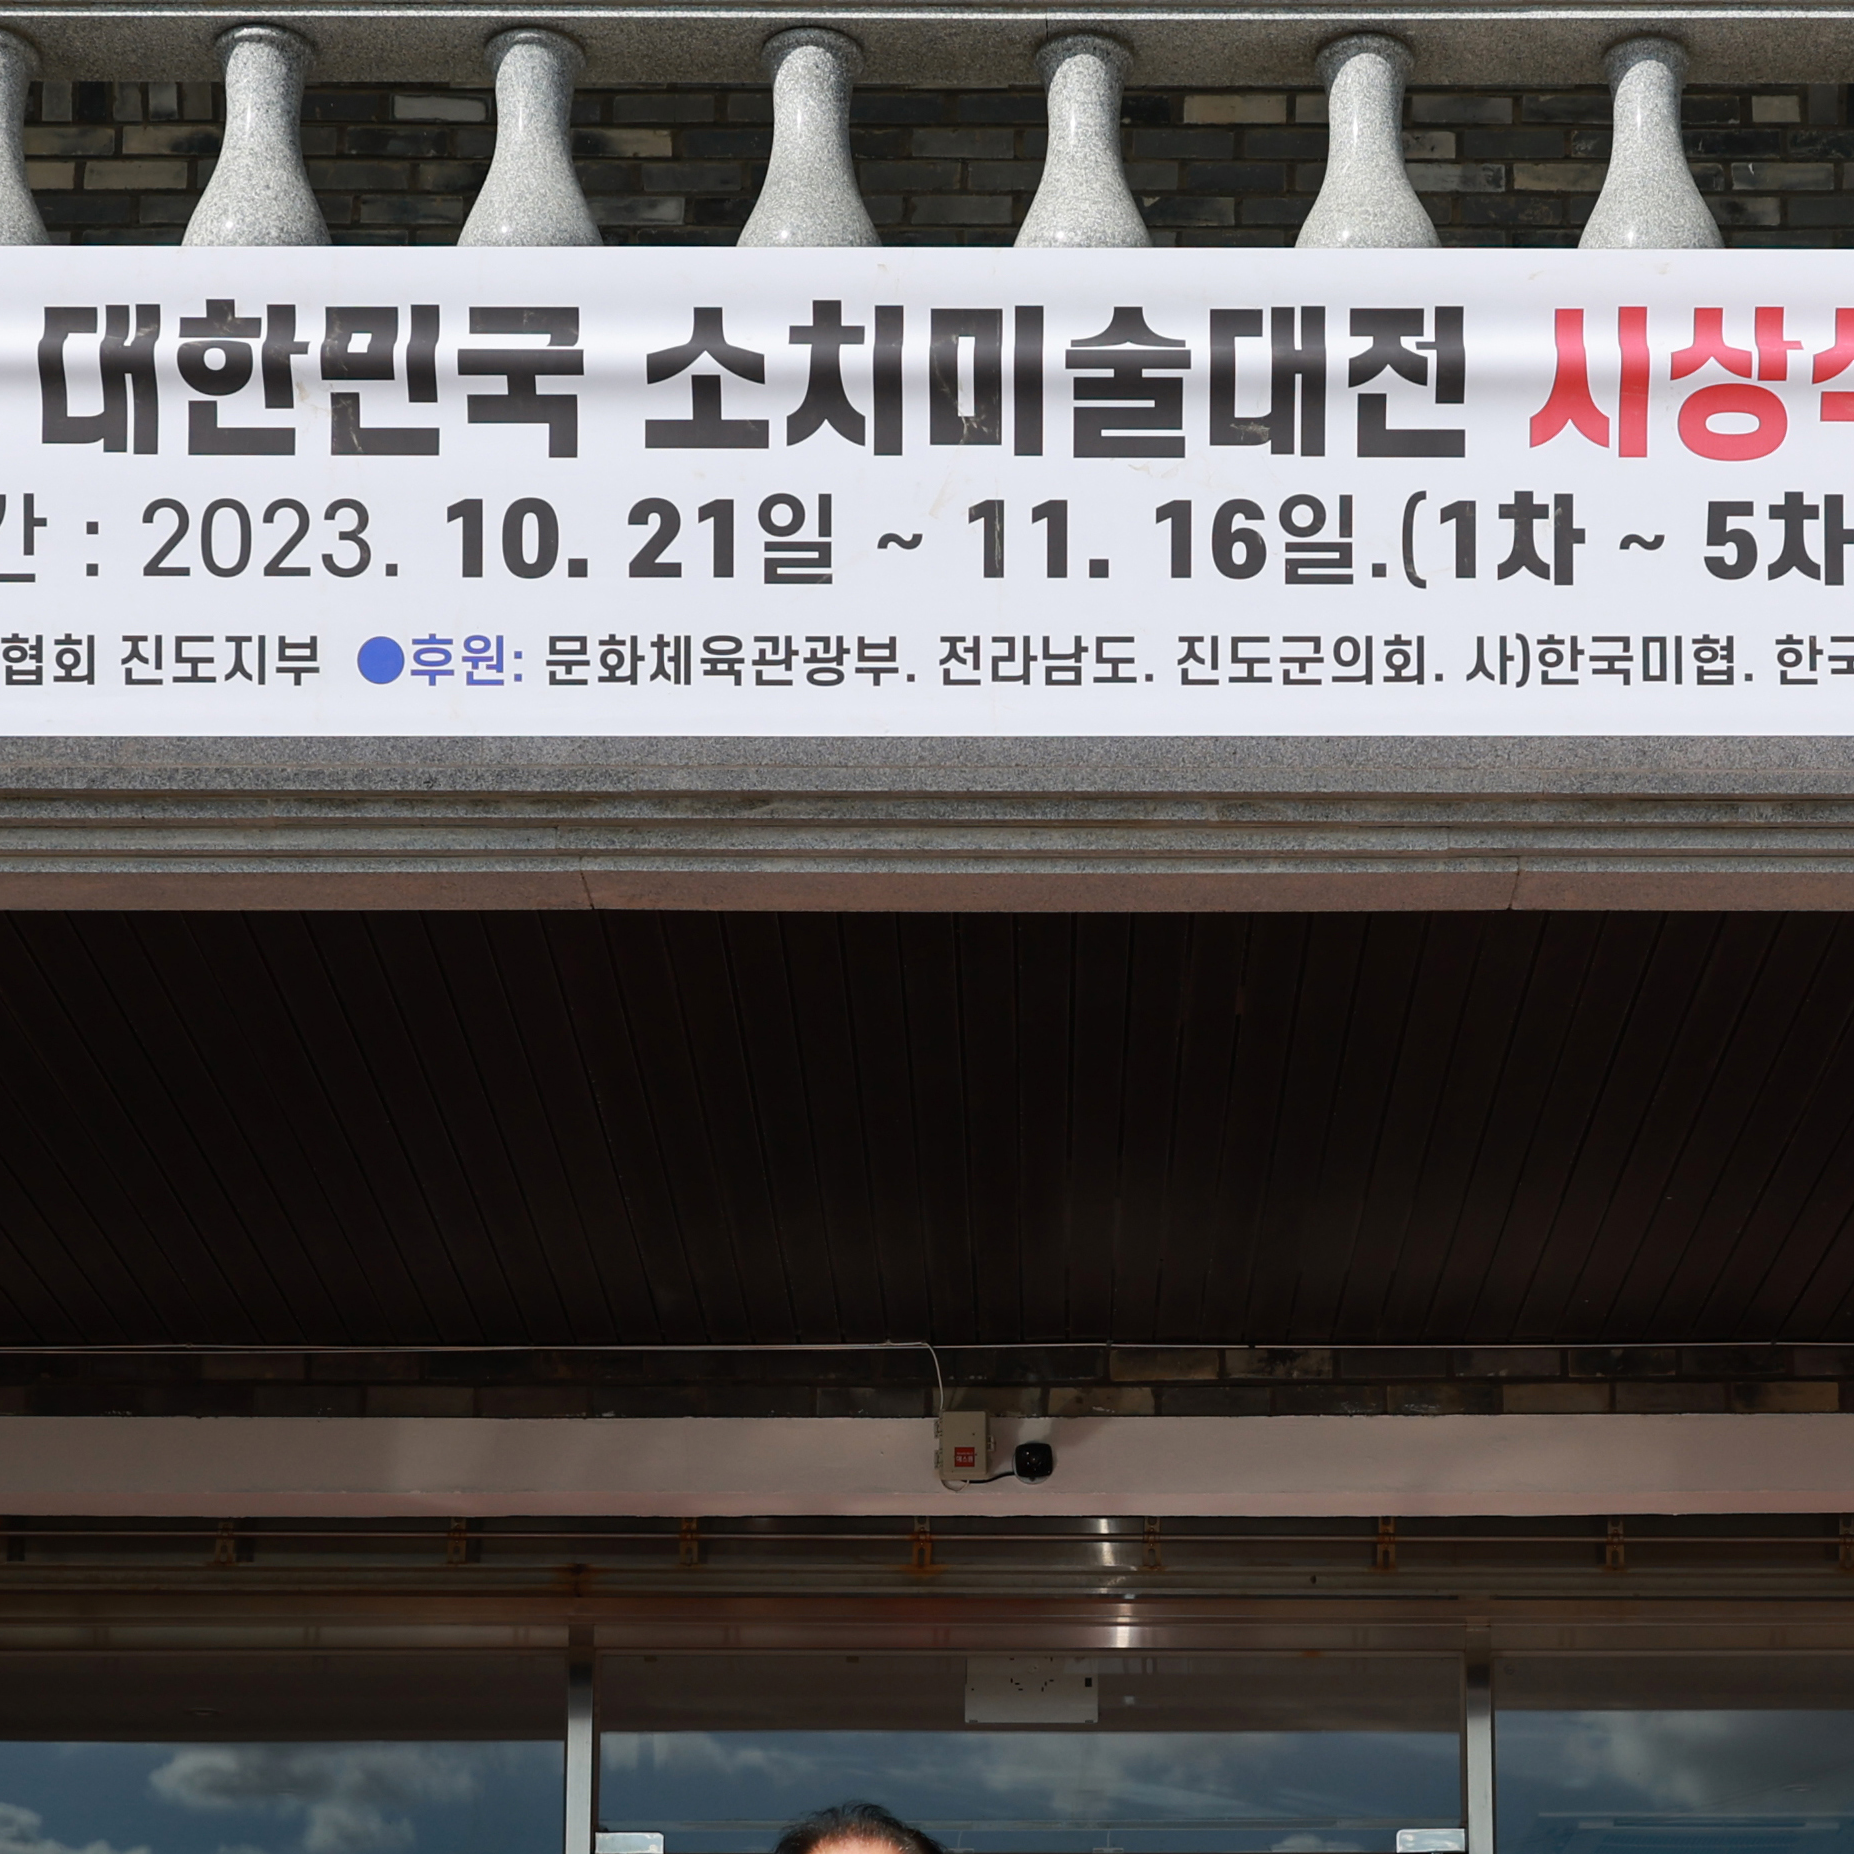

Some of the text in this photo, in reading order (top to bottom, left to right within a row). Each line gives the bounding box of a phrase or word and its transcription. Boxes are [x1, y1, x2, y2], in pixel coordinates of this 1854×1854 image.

[37, 298, 585, 458] 대한민국
[645, 299, 1466, 459] 소치미술대전
[142, 497, 398, 579] 2023.
[446, 498, 588, 580] 10.
[627, 492, 833, 585] 21일
[968, 498, 1110, 580] 11.
[120, 634, 320, 687] 진도지부
[409, 633, 523, 687] 후원:
[545, 632, 916, 687] 문화체육관광부.
[939, 635, 1154, 687] 전라남도.
[1177, 635, 1444, 686] 진도군의회.
[1466, 632, 1753, 688] 사)한국미협.
